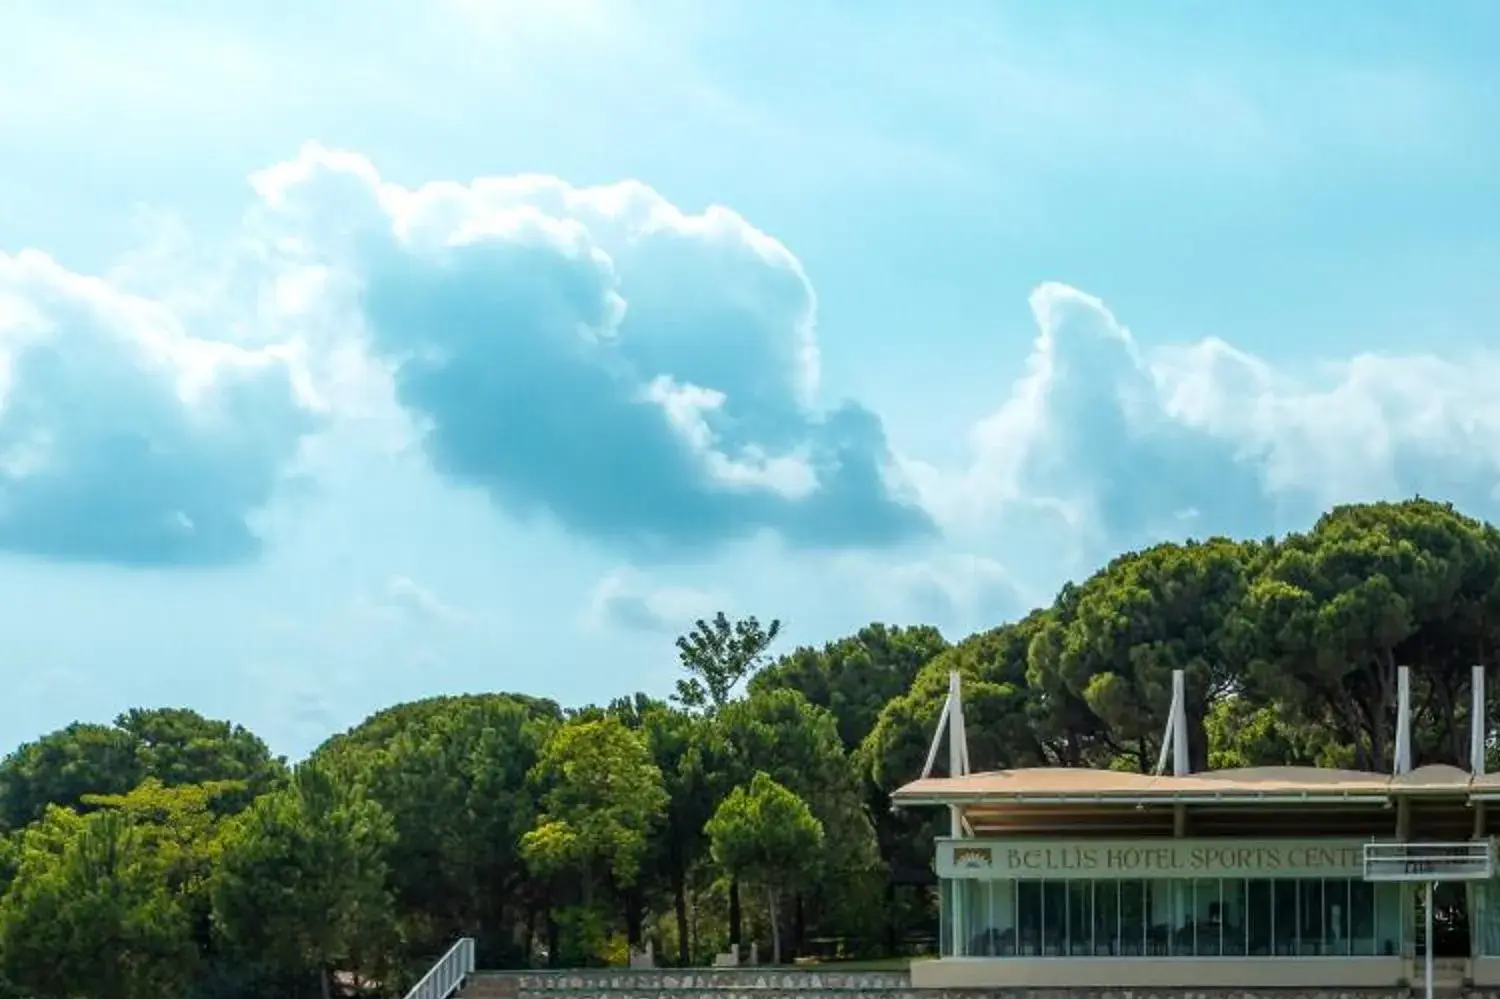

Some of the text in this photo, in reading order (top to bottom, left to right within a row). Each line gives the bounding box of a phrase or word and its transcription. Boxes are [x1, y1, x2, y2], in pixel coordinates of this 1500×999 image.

[1107, 848, 1183, 868] HOTEL
[1190, 848, 1280, 868] SPORTS
[1288, 847, 1365, 868] CENTE
